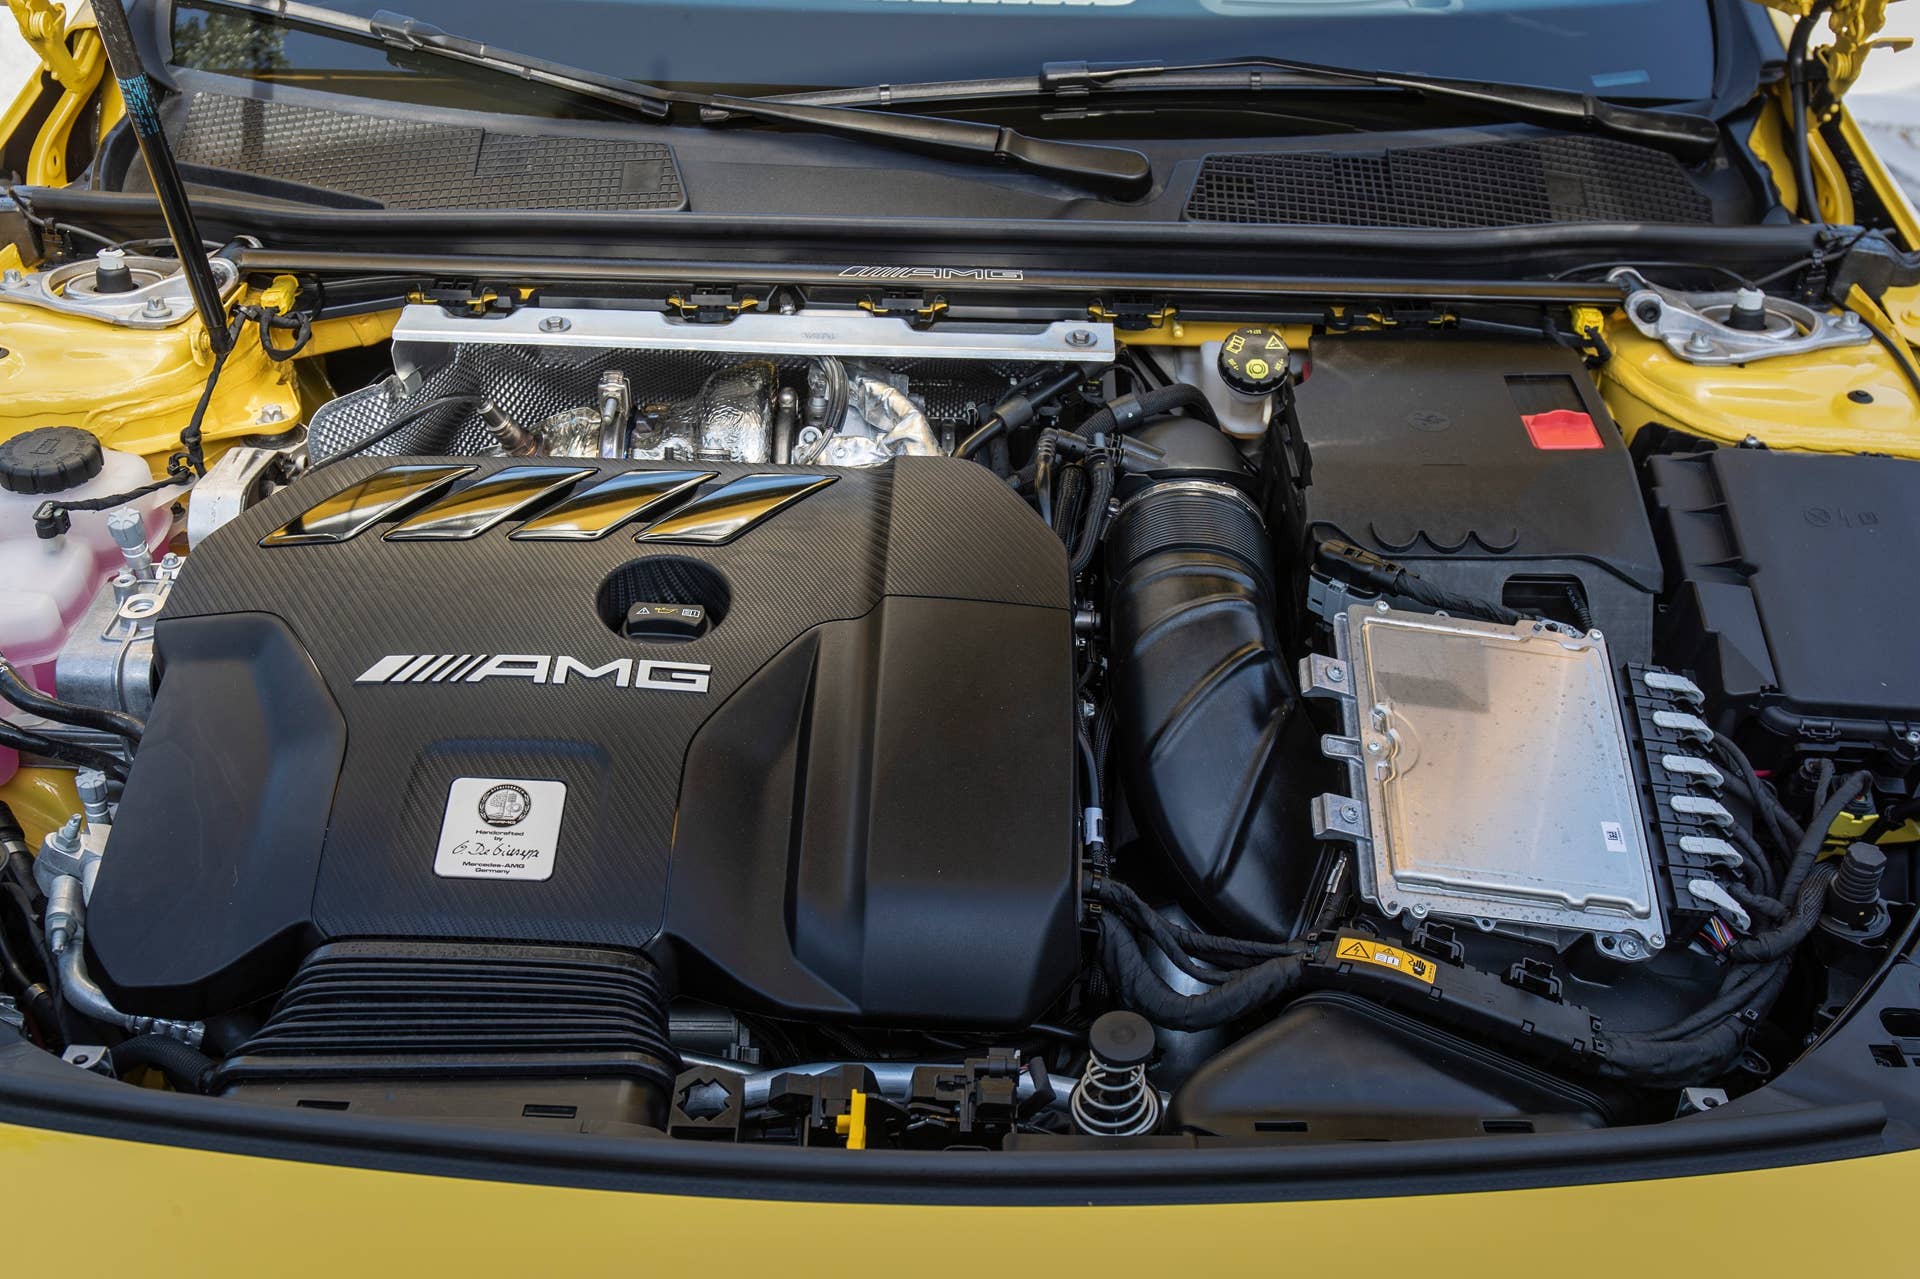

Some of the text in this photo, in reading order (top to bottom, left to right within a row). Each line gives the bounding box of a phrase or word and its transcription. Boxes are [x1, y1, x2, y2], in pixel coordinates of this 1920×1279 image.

[465, 654, 712, 693] AMG
[475, 829, 525, 837] Handcrafted
[462, 861, 525, 869] Mercedes-AMG
